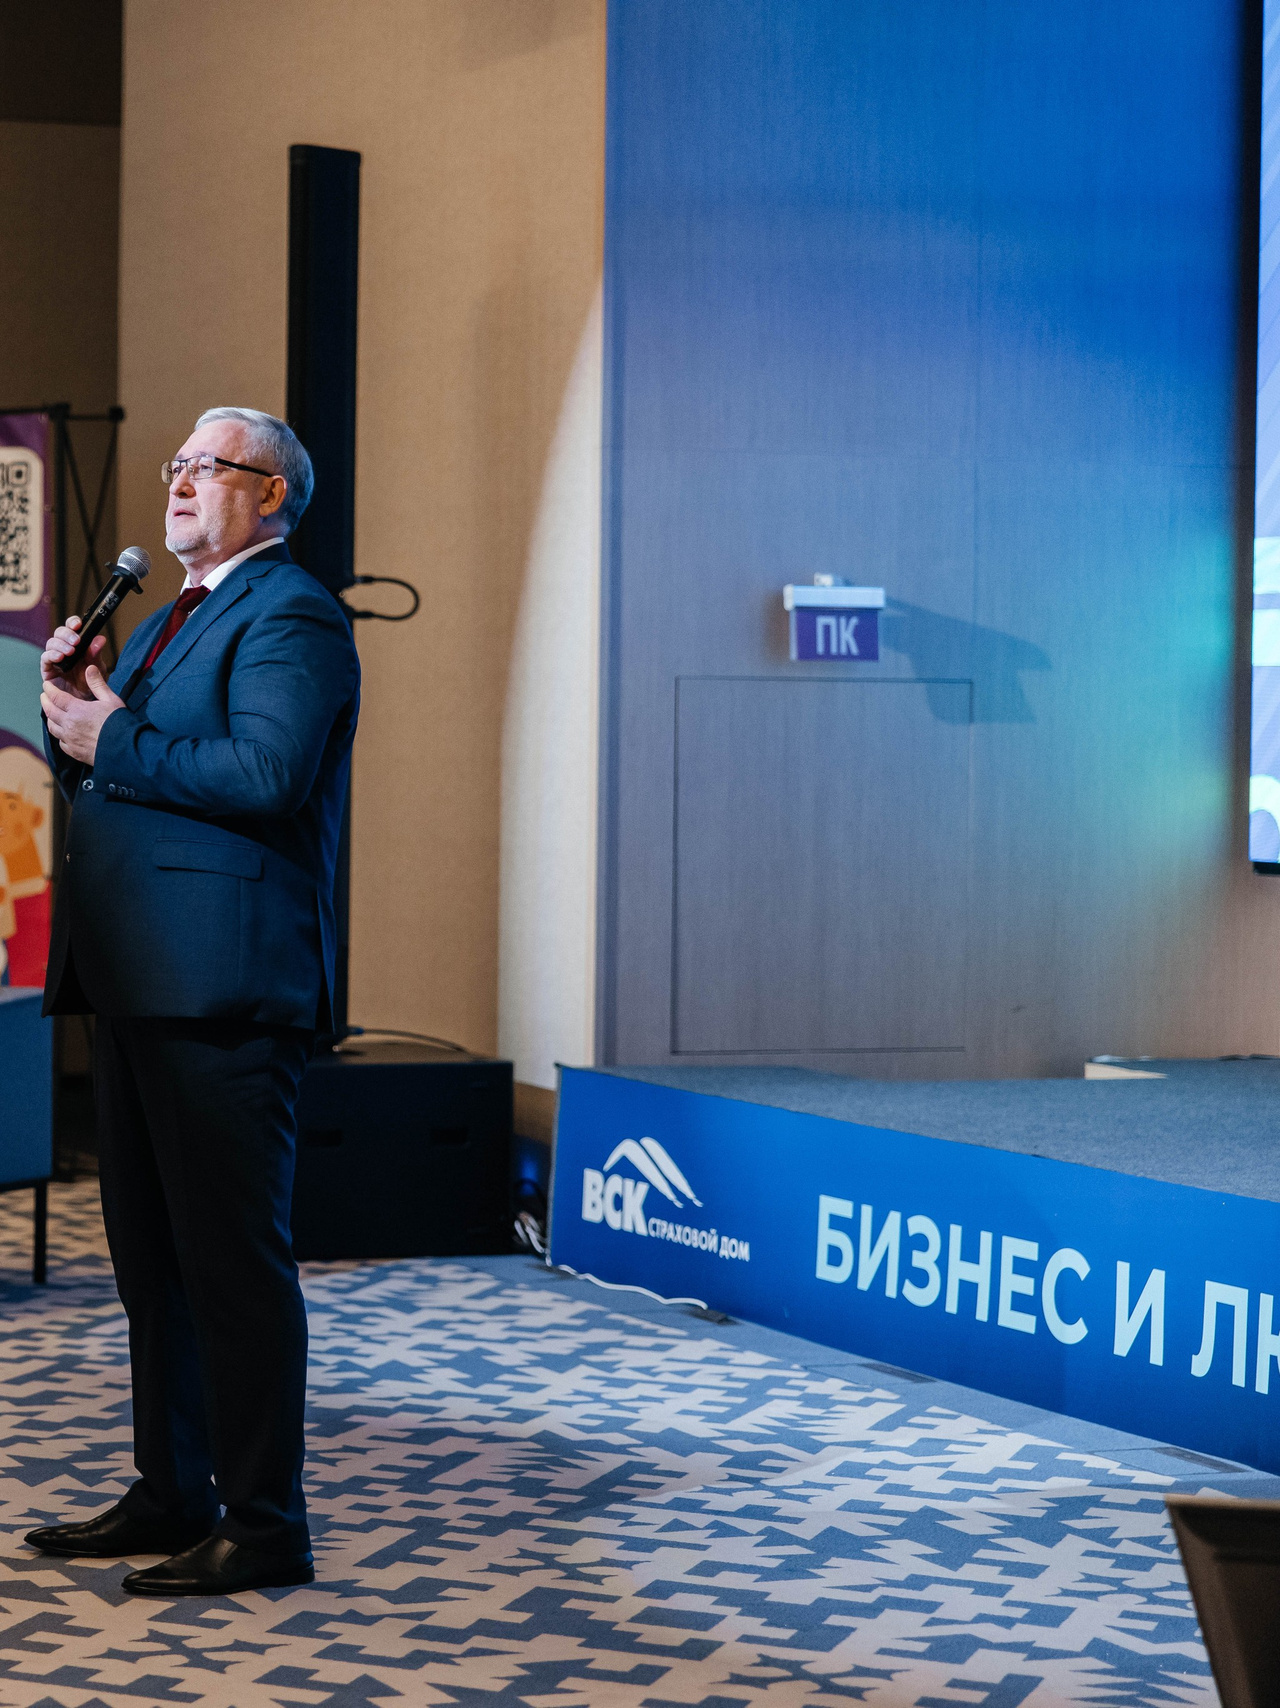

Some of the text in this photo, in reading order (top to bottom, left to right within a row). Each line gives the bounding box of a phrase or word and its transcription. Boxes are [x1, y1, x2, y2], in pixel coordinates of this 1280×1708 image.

[816, 615, 859, 655] ПК
[581, 1168, 650, 1237] ВСК
[648, 1217, 750, 1262] СТРАХОВОЙ ДОМ
[816, 1194, 1091, 1345] БИЗНЕС
[1113, 1261, 1166, 1366] И
